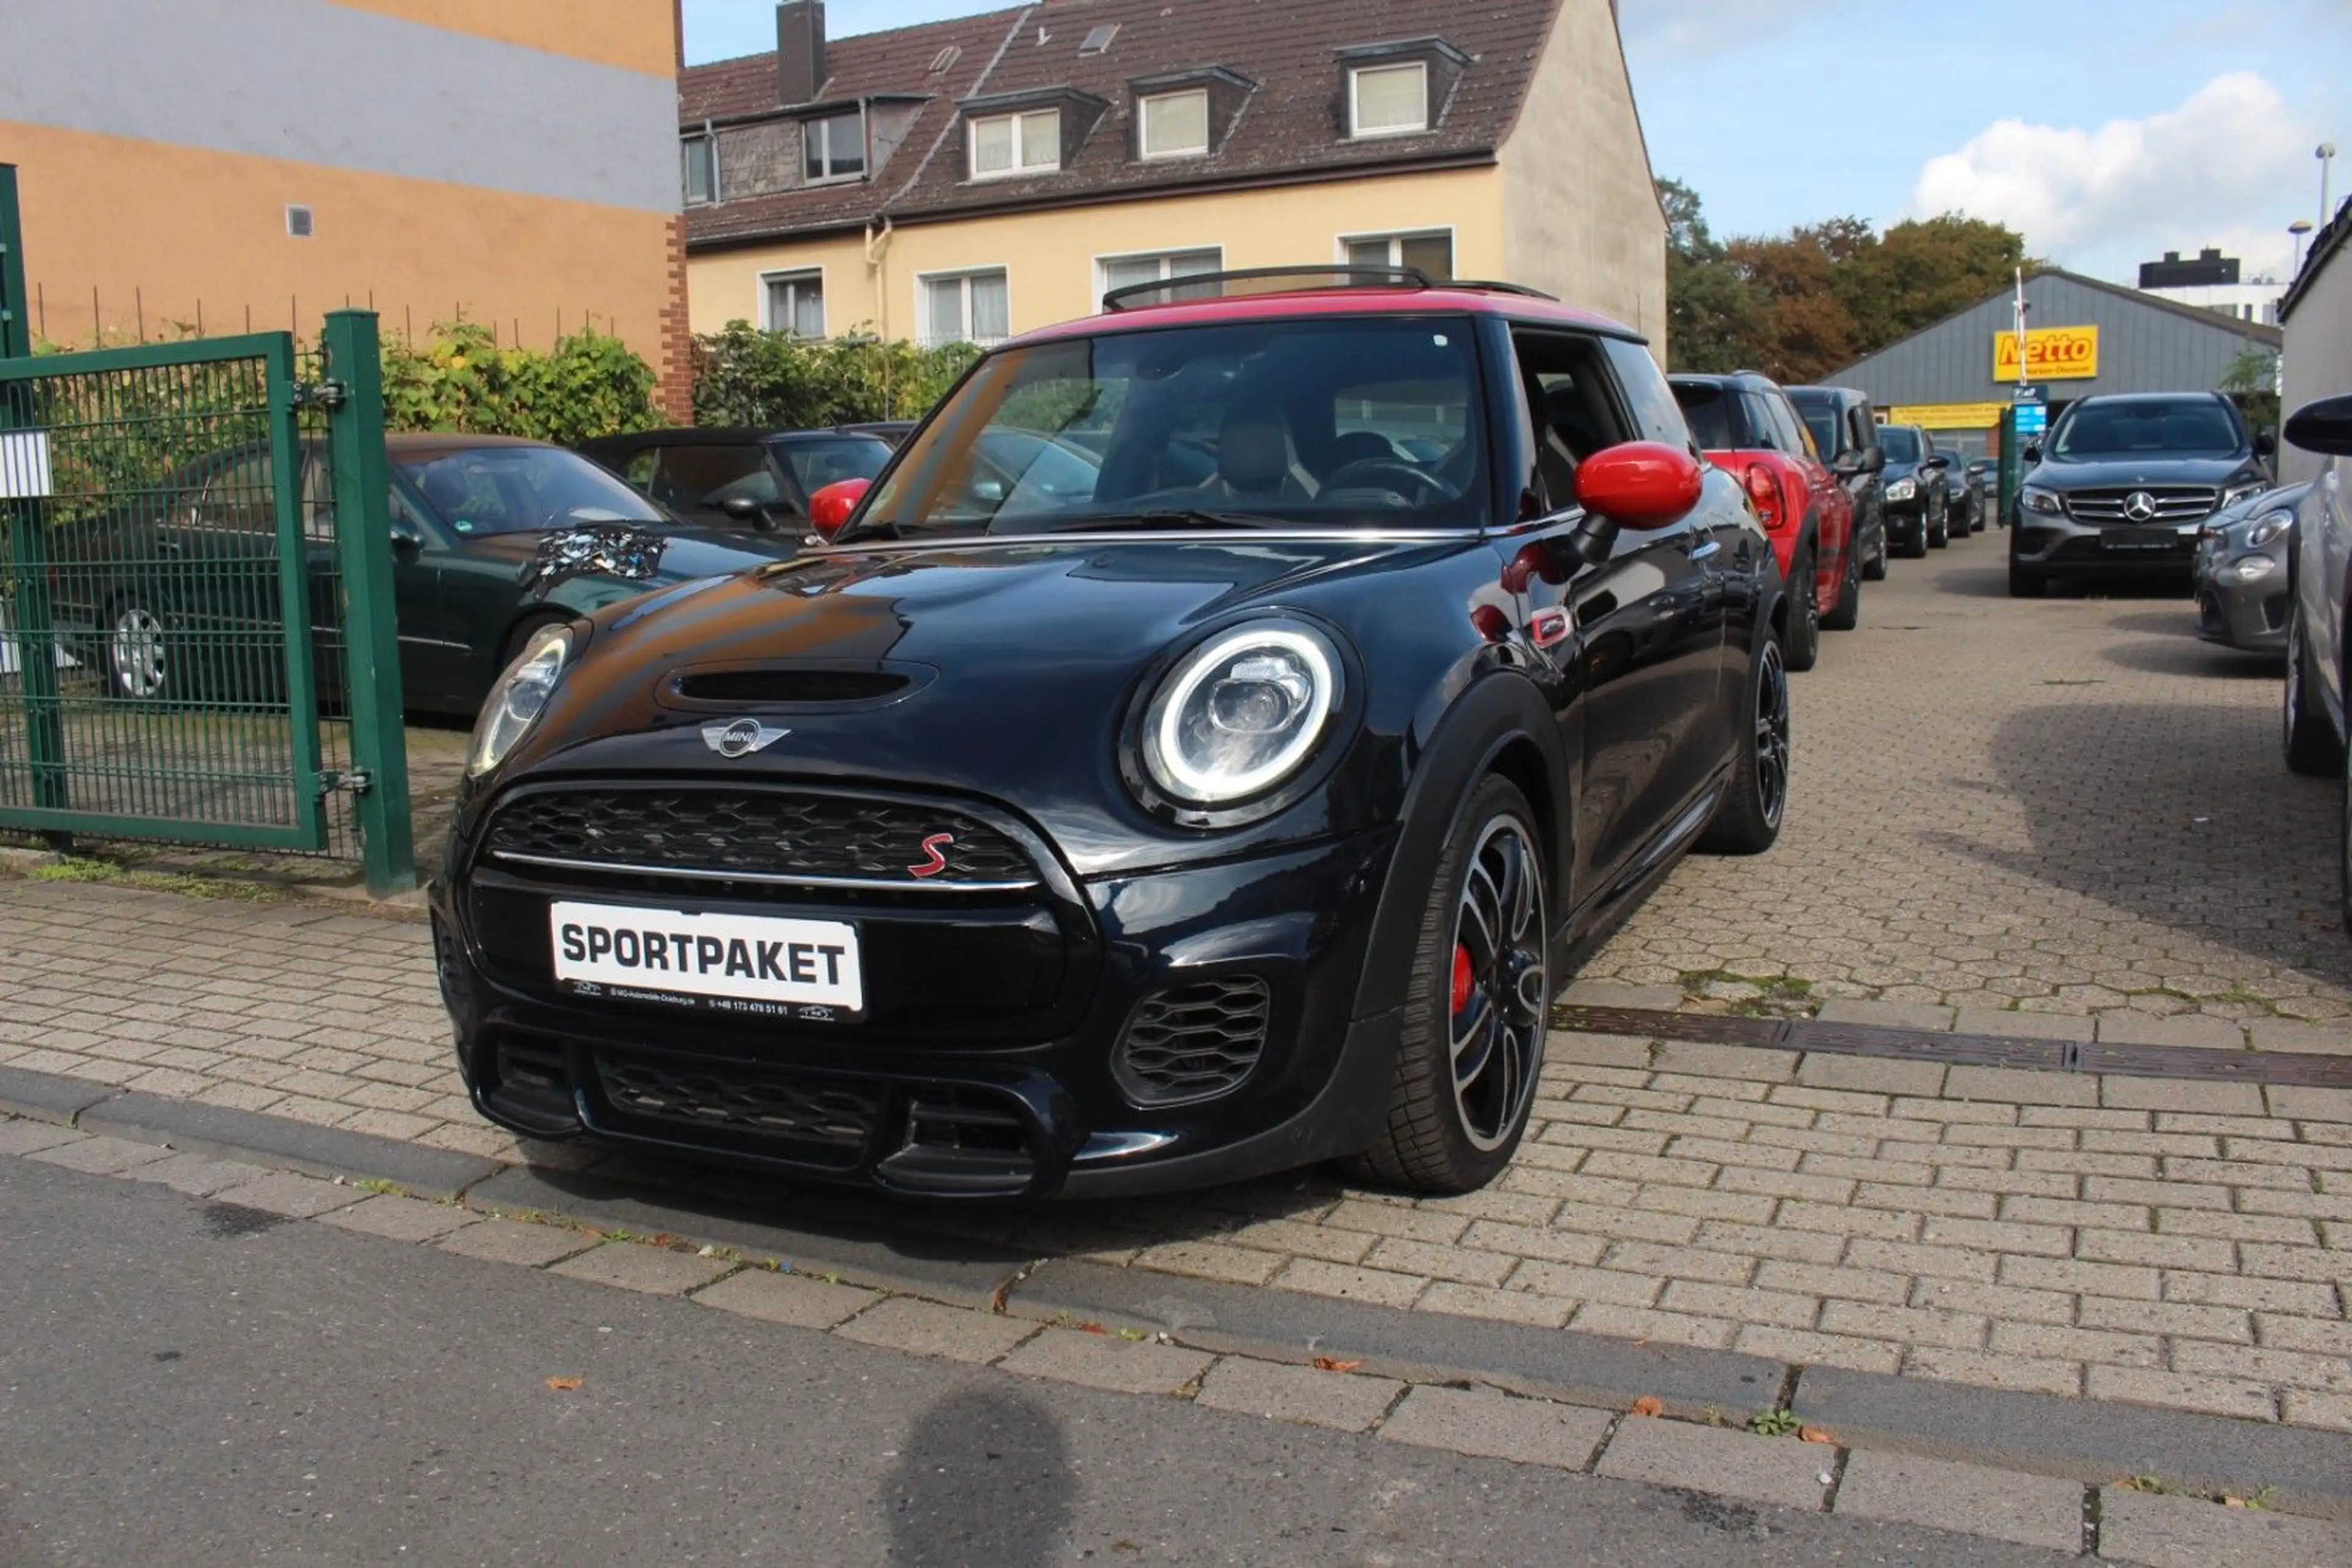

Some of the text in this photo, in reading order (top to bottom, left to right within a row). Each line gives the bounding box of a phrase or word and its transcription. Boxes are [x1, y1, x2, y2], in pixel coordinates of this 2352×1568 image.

[1999, 334, 2092, 366] Netto
[726, 731, 755, 742] MINI
[907, 833, 954, 877] S
[562, 924, 845, 986] SPORTPAKET
